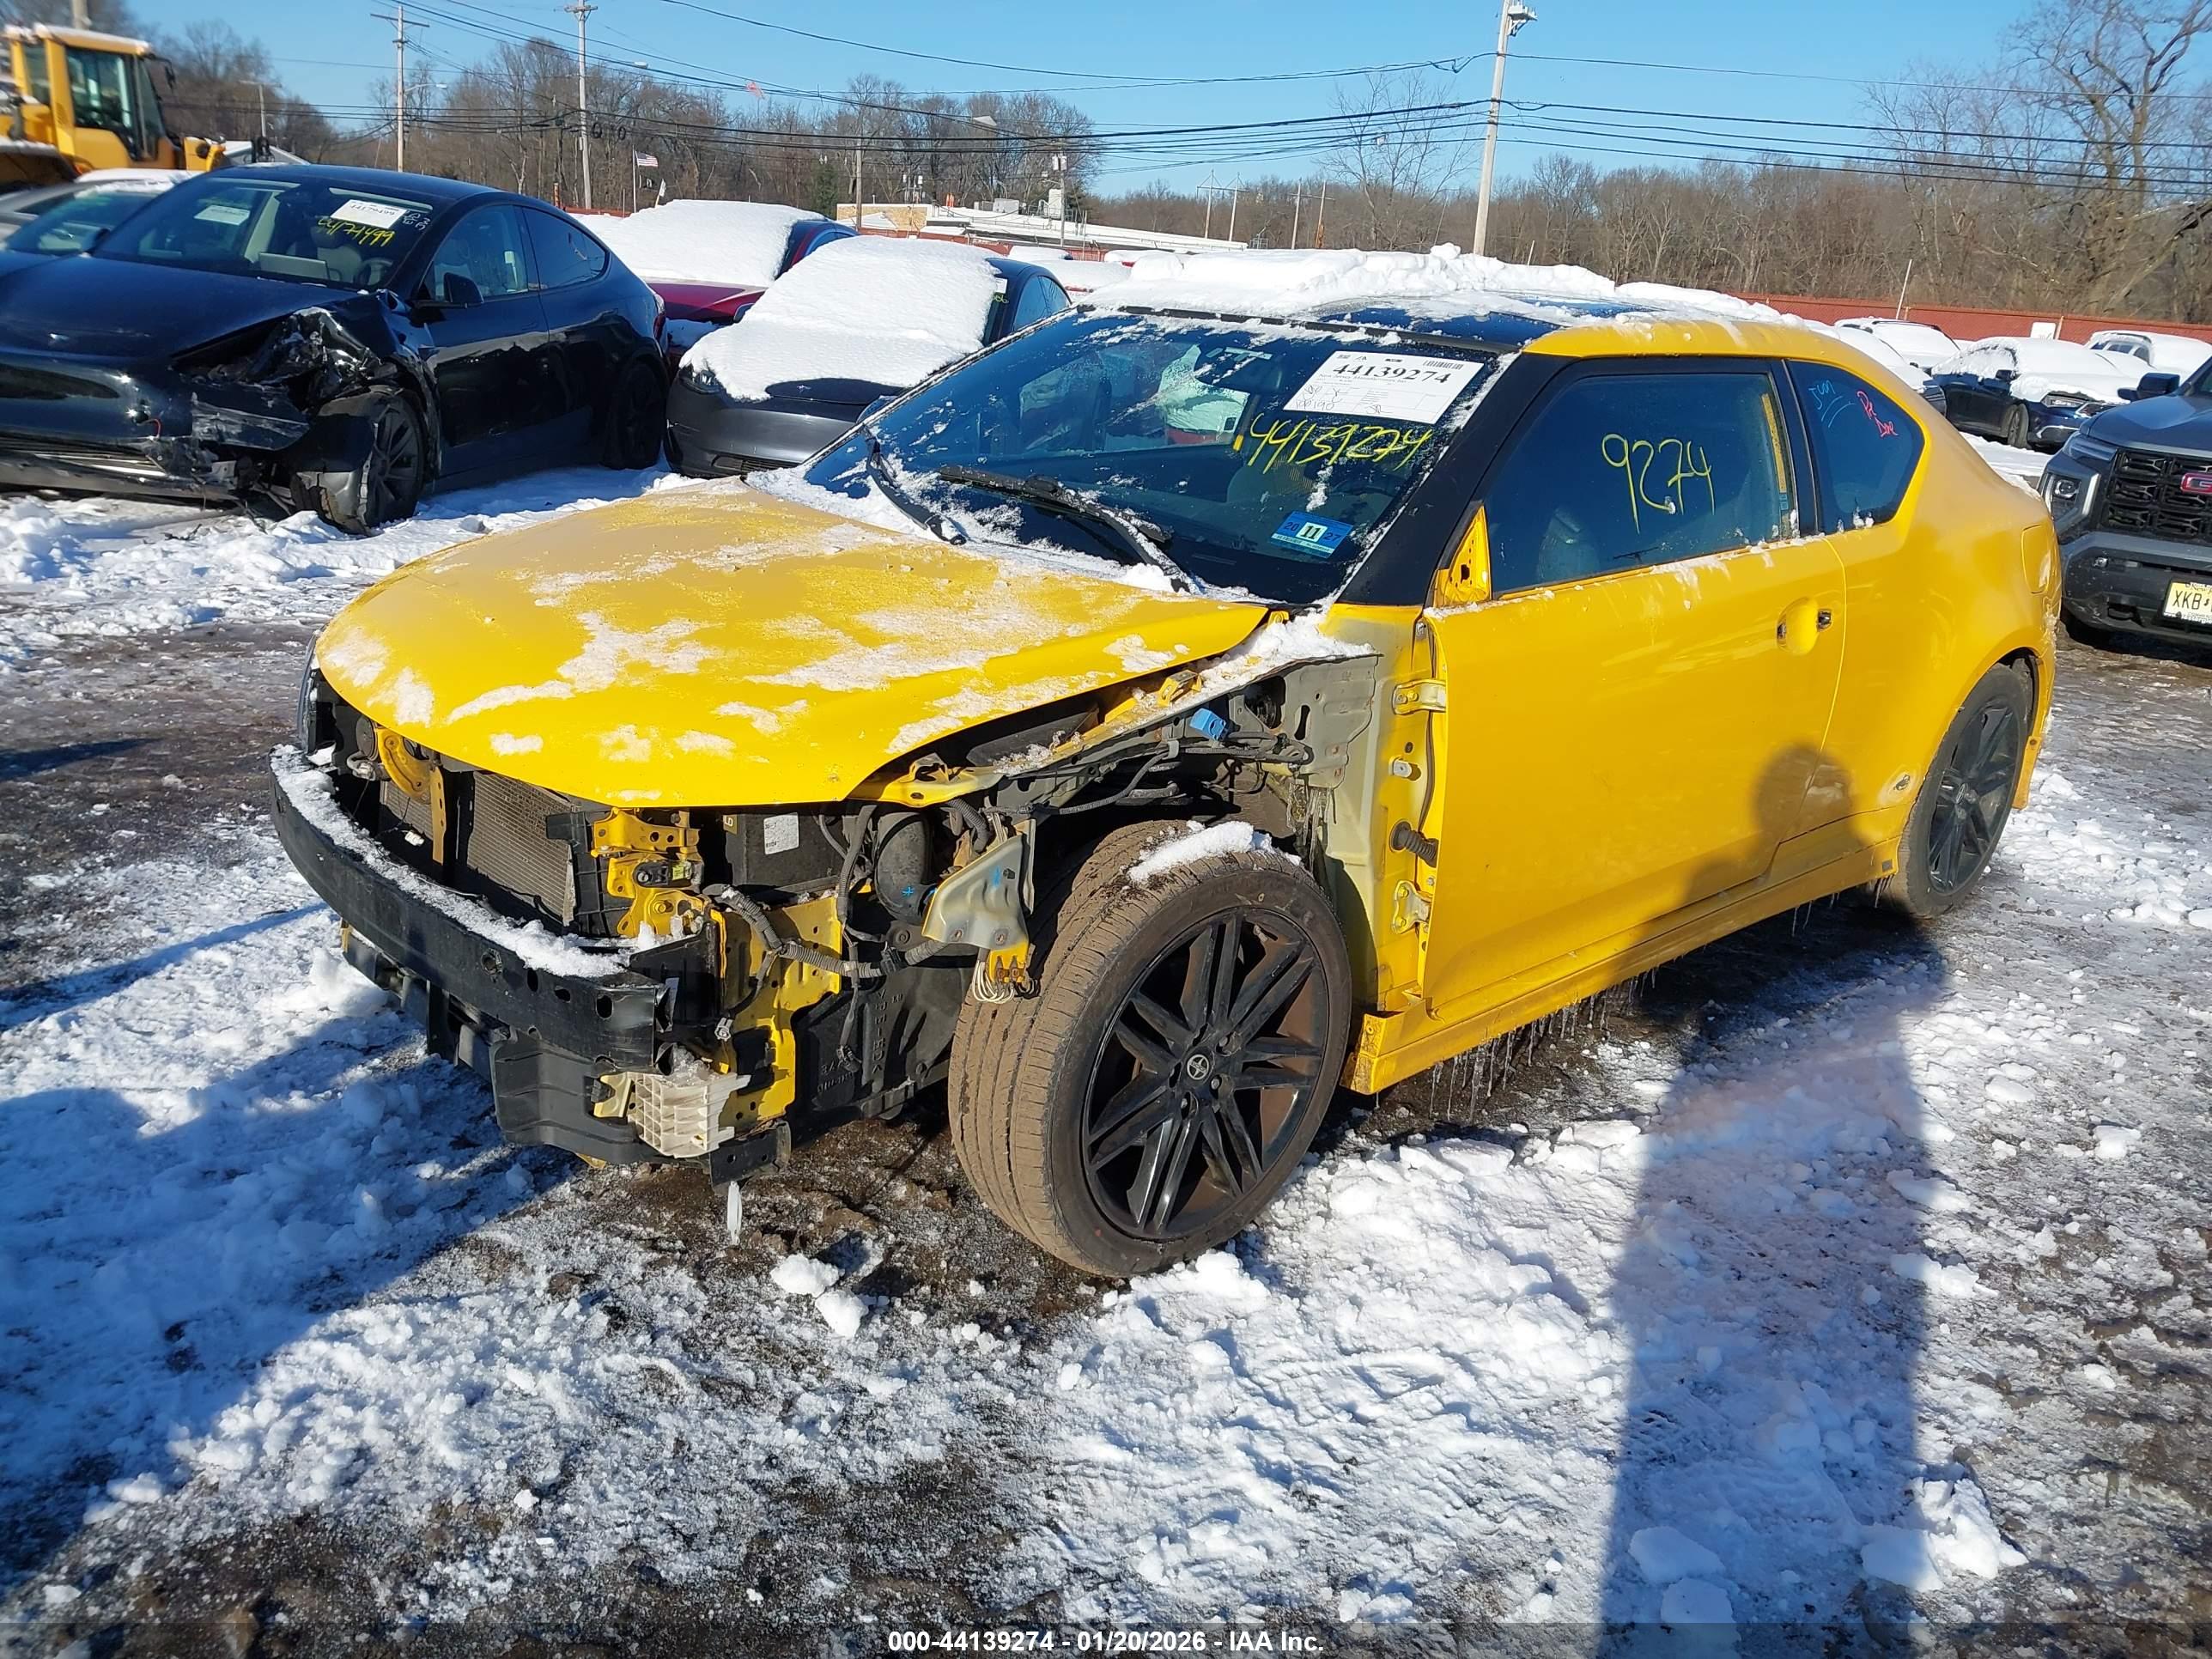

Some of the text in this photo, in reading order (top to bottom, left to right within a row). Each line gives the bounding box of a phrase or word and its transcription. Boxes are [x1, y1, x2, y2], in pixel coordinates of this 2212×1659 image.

[1332, 362, 1452, 384] 44139274
[1246, 412, 1433, 475] 44139274
[1601, 433, 1715, 534] 9274
[1284, 521, 1300, 532] 20
[1300, 525, 1322, 540] 11
[1323, 532, 1341, 542] 27
